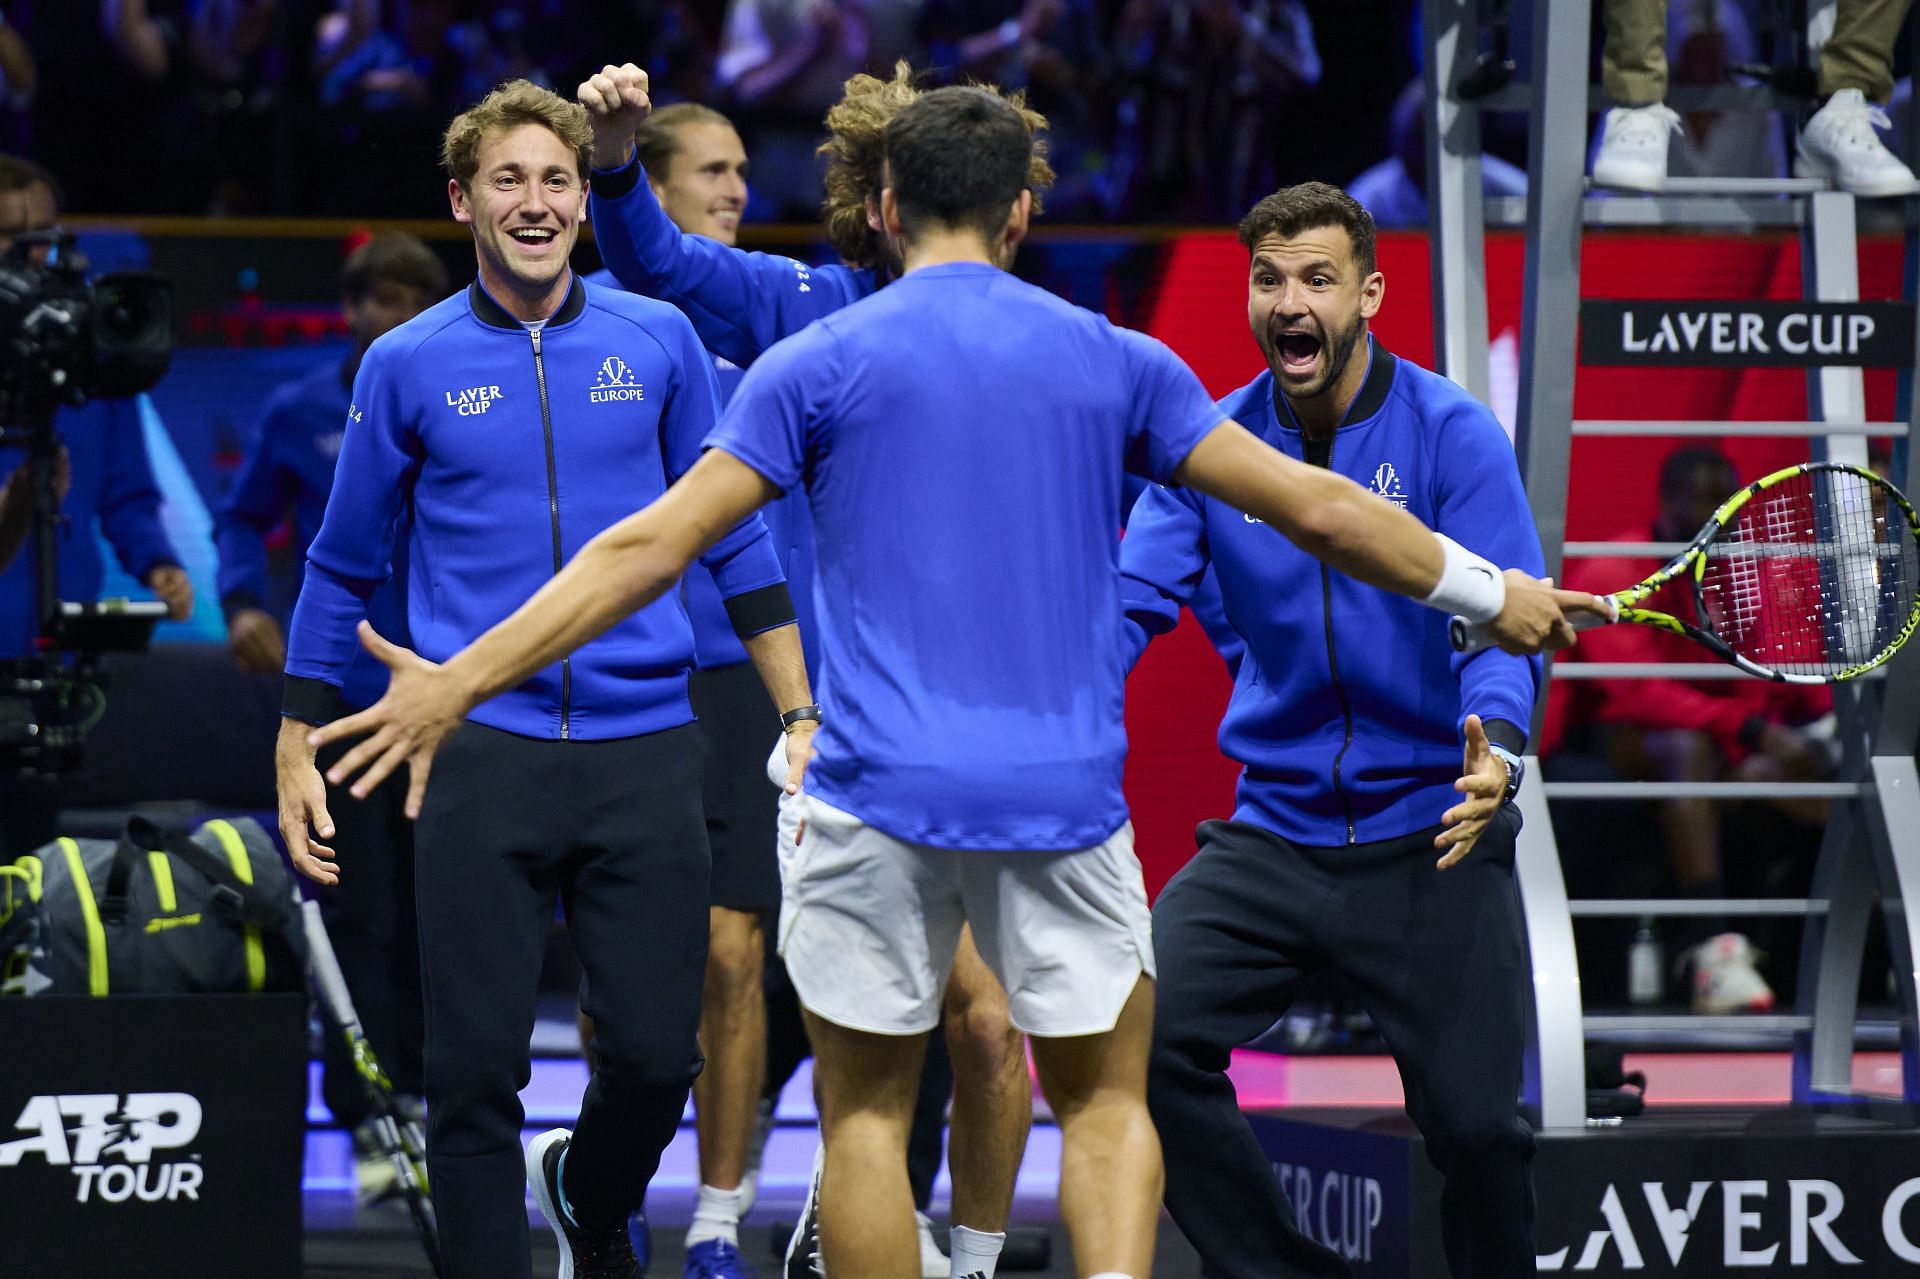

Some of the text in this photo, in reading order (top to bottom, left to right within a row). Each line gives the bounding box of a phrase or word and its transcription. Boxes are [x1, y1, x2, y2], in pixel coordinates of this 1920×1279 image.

[1622, 312, 1875, 354] LAVER CUP
[446, 385, 503, 406] LAVER
[458, 400, 491, 416] CUP
[590, 388, 644, 403] EUROPE
[0, 1092, 203, 1166] ATP
[71, 1163, 204, 1204] TOUR
[1320, 1169, 1383, 1263] CUP
